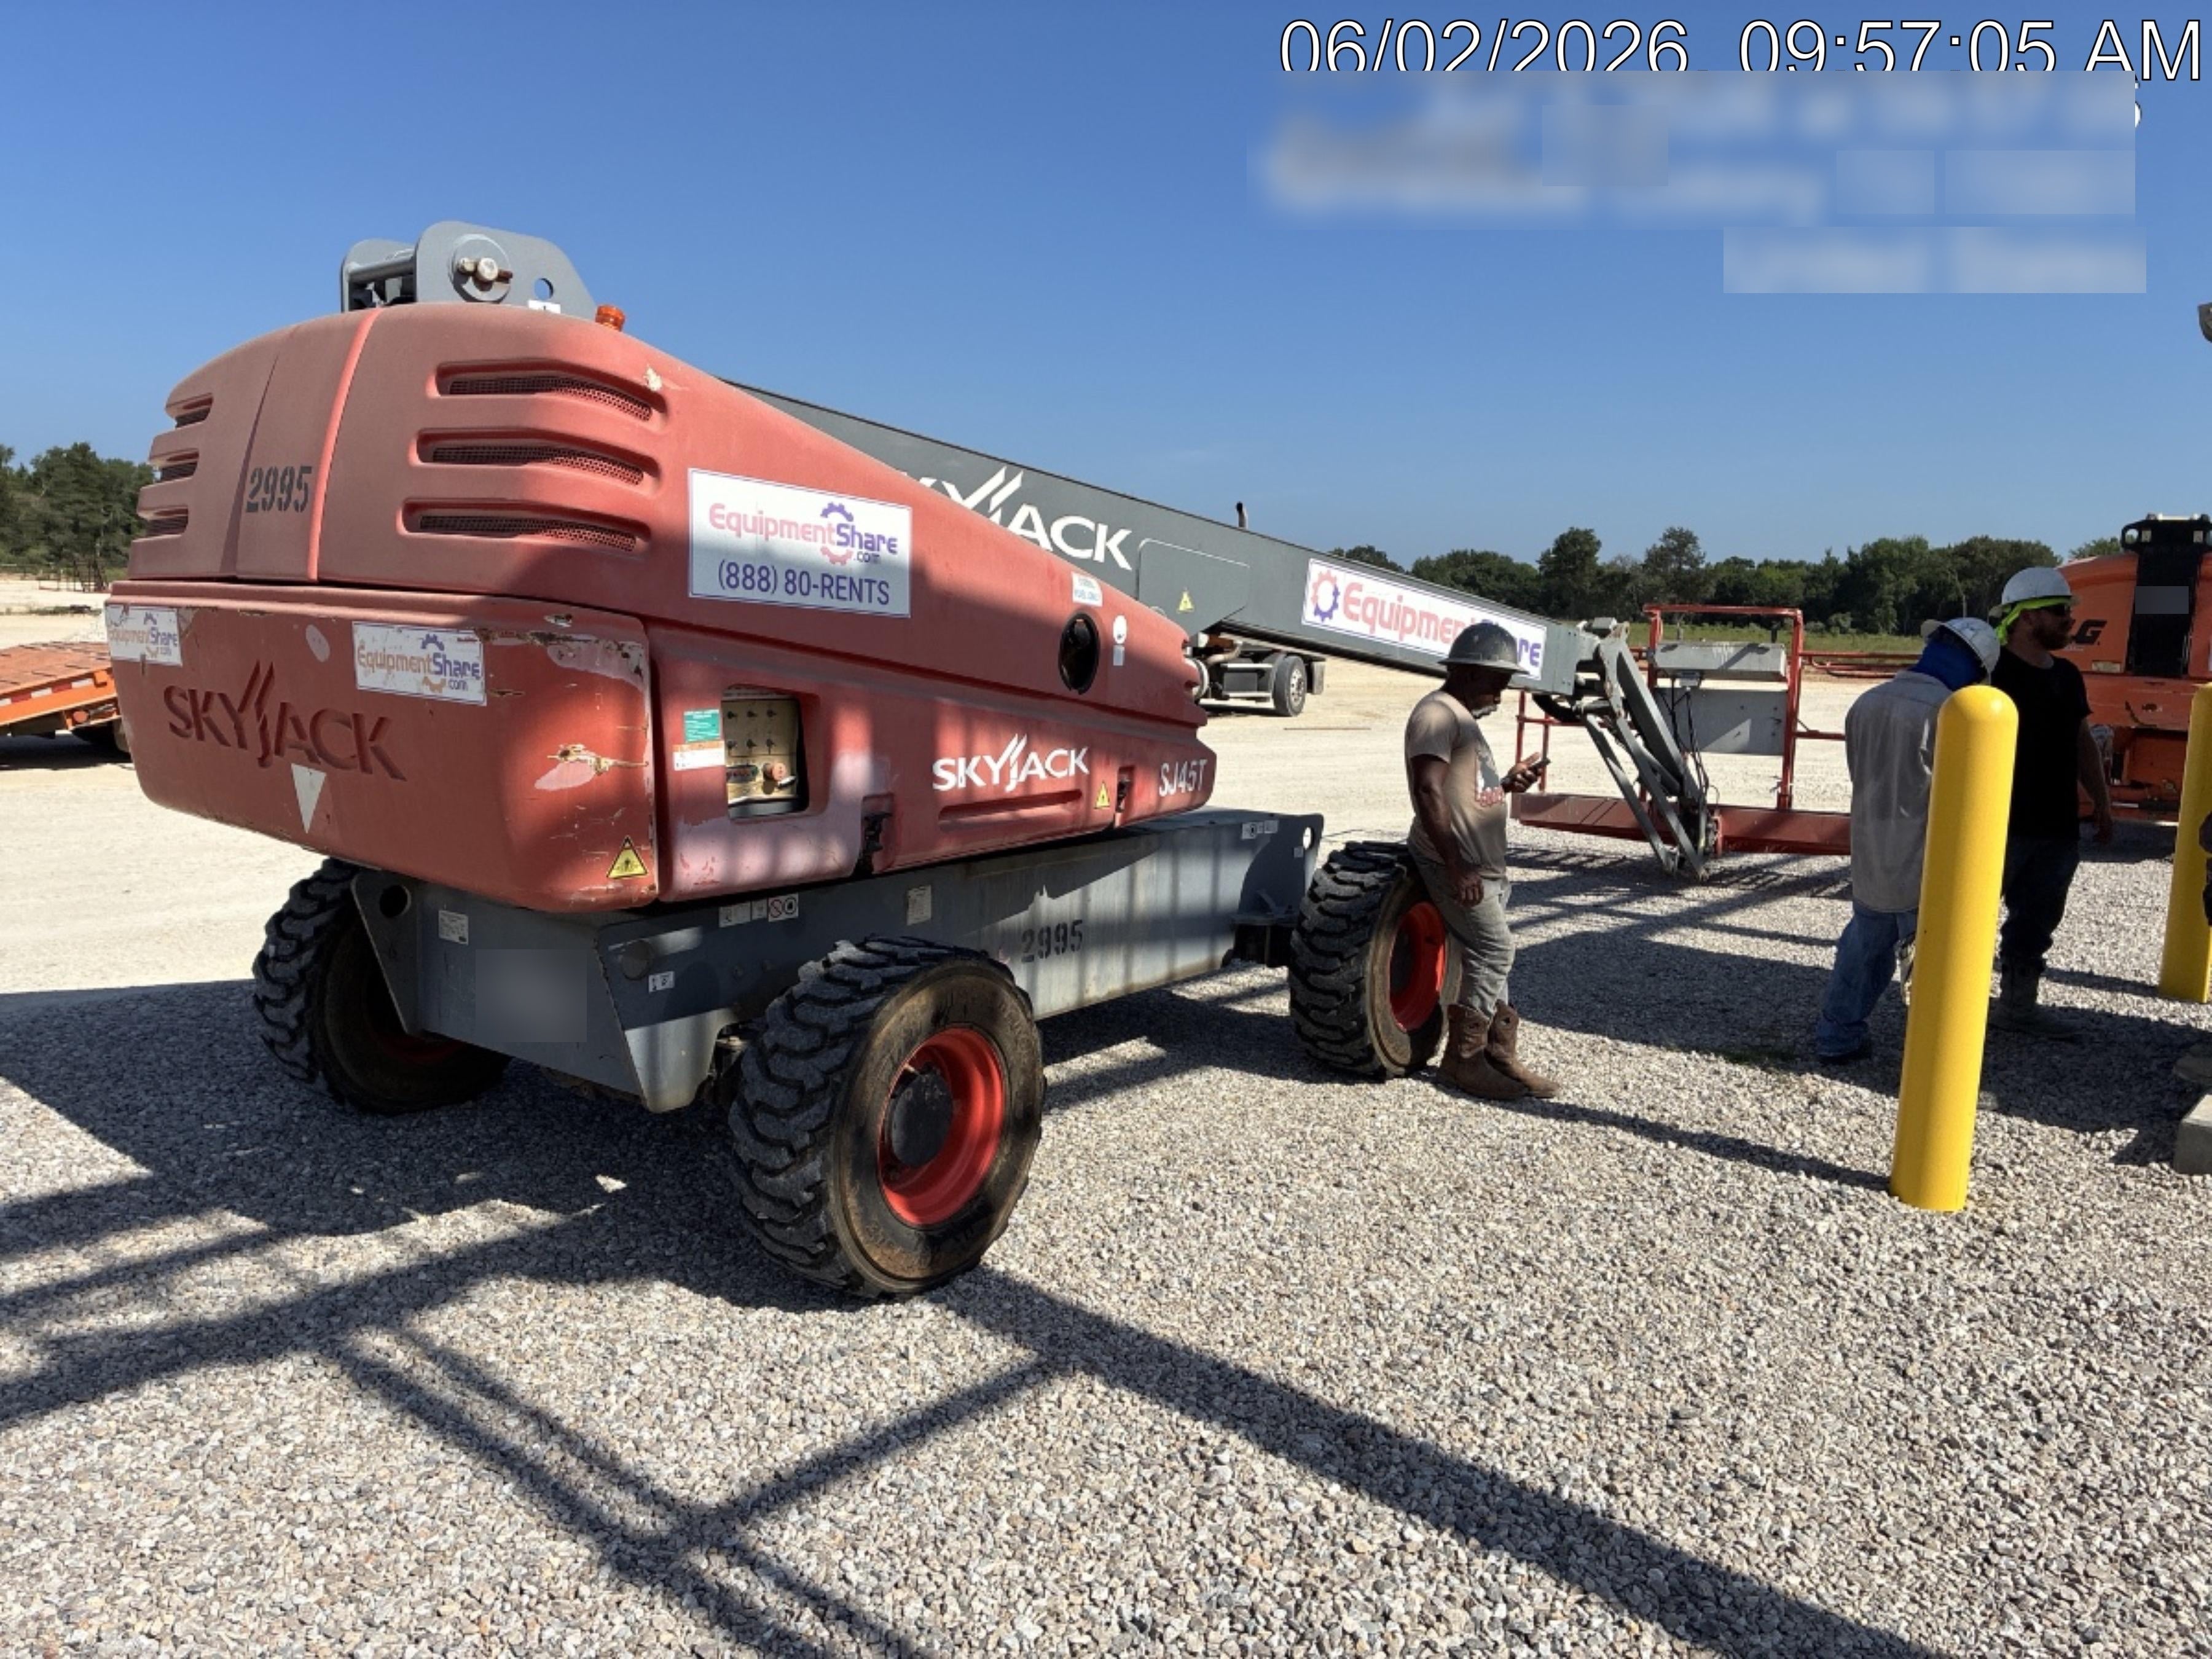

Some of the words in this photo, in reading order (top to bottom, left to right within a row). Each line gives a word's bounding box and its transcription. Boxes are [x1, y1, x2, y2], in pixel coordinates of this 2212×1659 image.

[246, 465, 312, 514] 2995
[709, 503, 898, 554] EquipmentShare
[718, 559, 778, 594] (888)
[784, 569, 890, 605] 80-RENTS
[357, 648, 480, 680] EquipmentShare
[163, 661, 407, 780] SKYJACK
[932, 734, 1089, 792] SKYJACK
[1159, 759, 1208, 797] SJ45T
[1021, 919, 1083, 962] 2995
